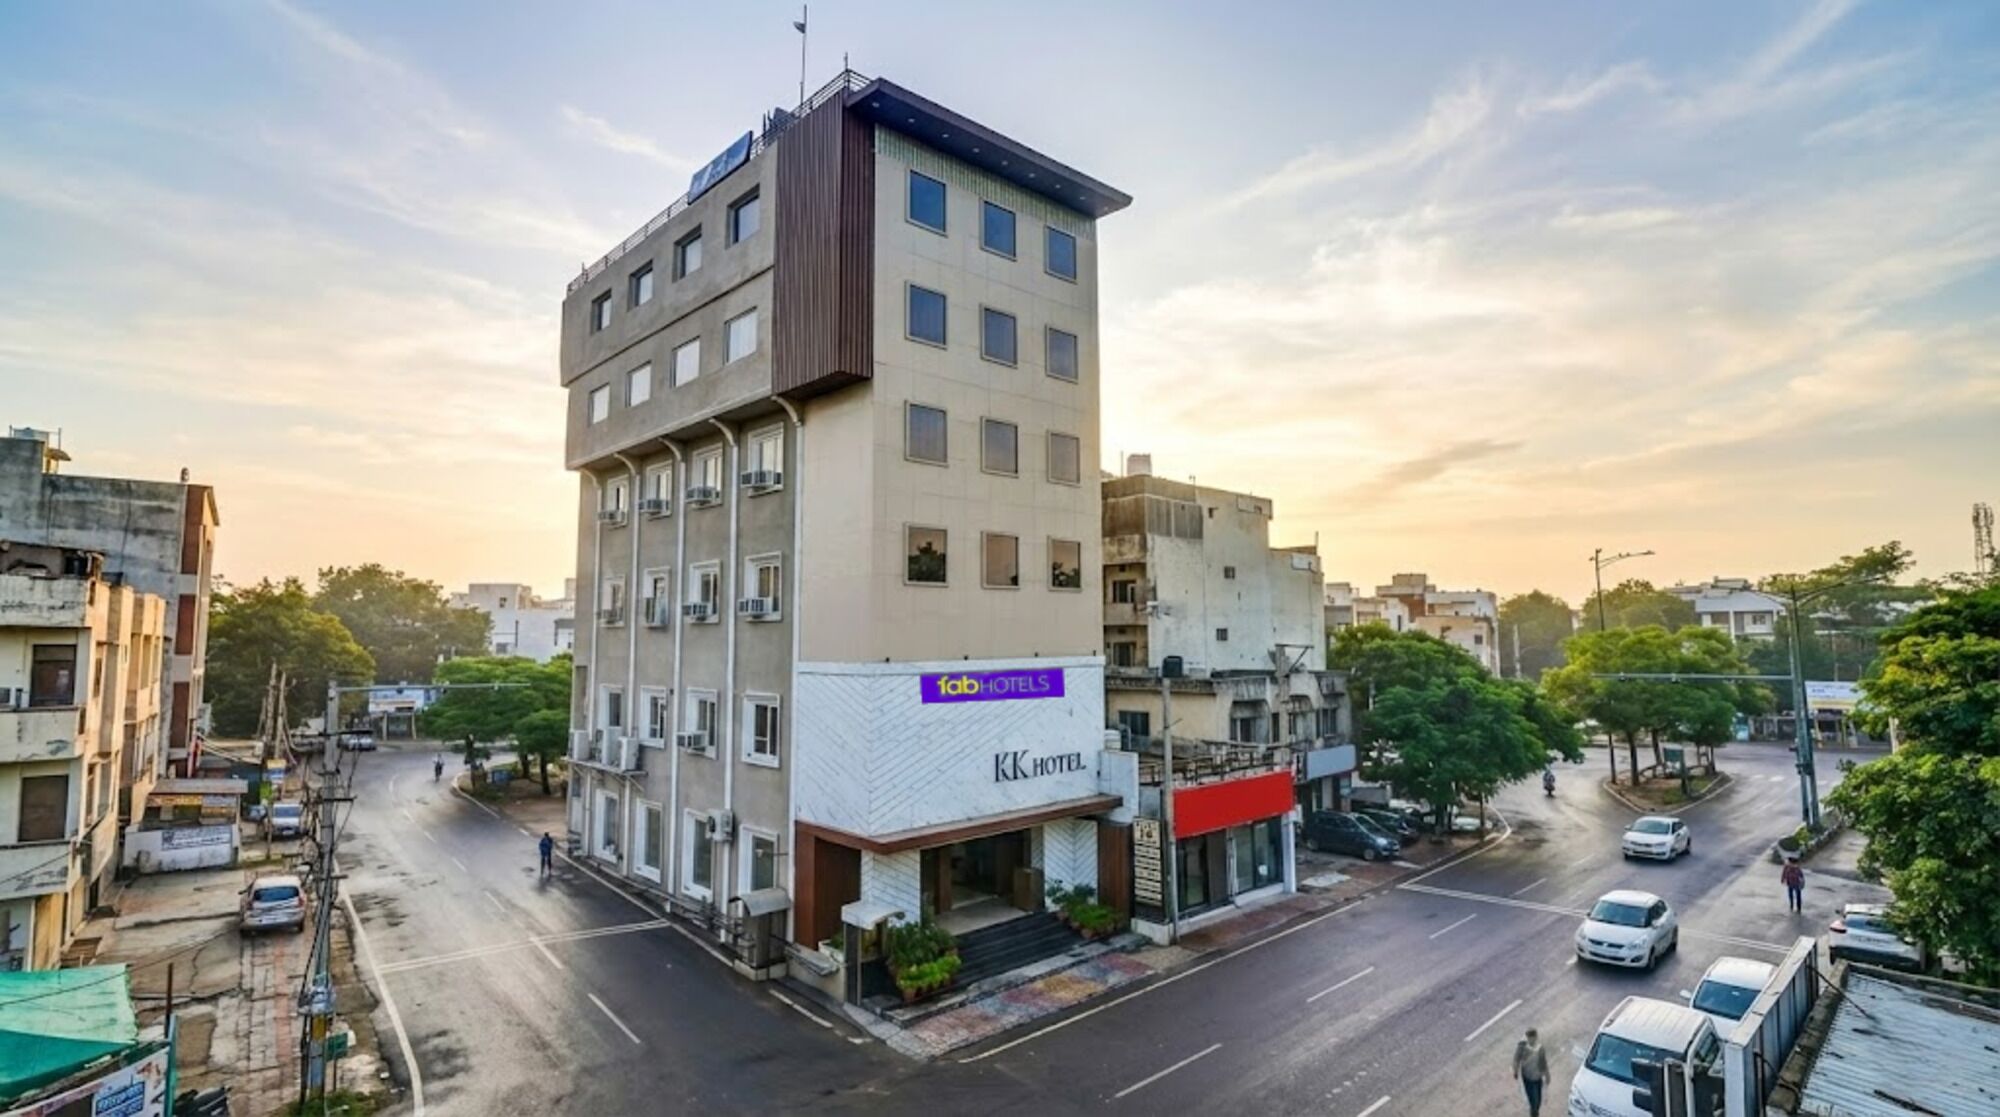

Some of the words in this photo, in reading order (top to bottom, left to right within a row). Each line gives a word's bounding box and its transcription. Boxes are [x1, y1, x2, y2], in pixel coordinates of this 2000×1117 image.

[937, 674, 1050, 696] fabHOTELS
[994, 750, 1029, 783] KK
[1033, 752, 1087, 778] HOTEL
